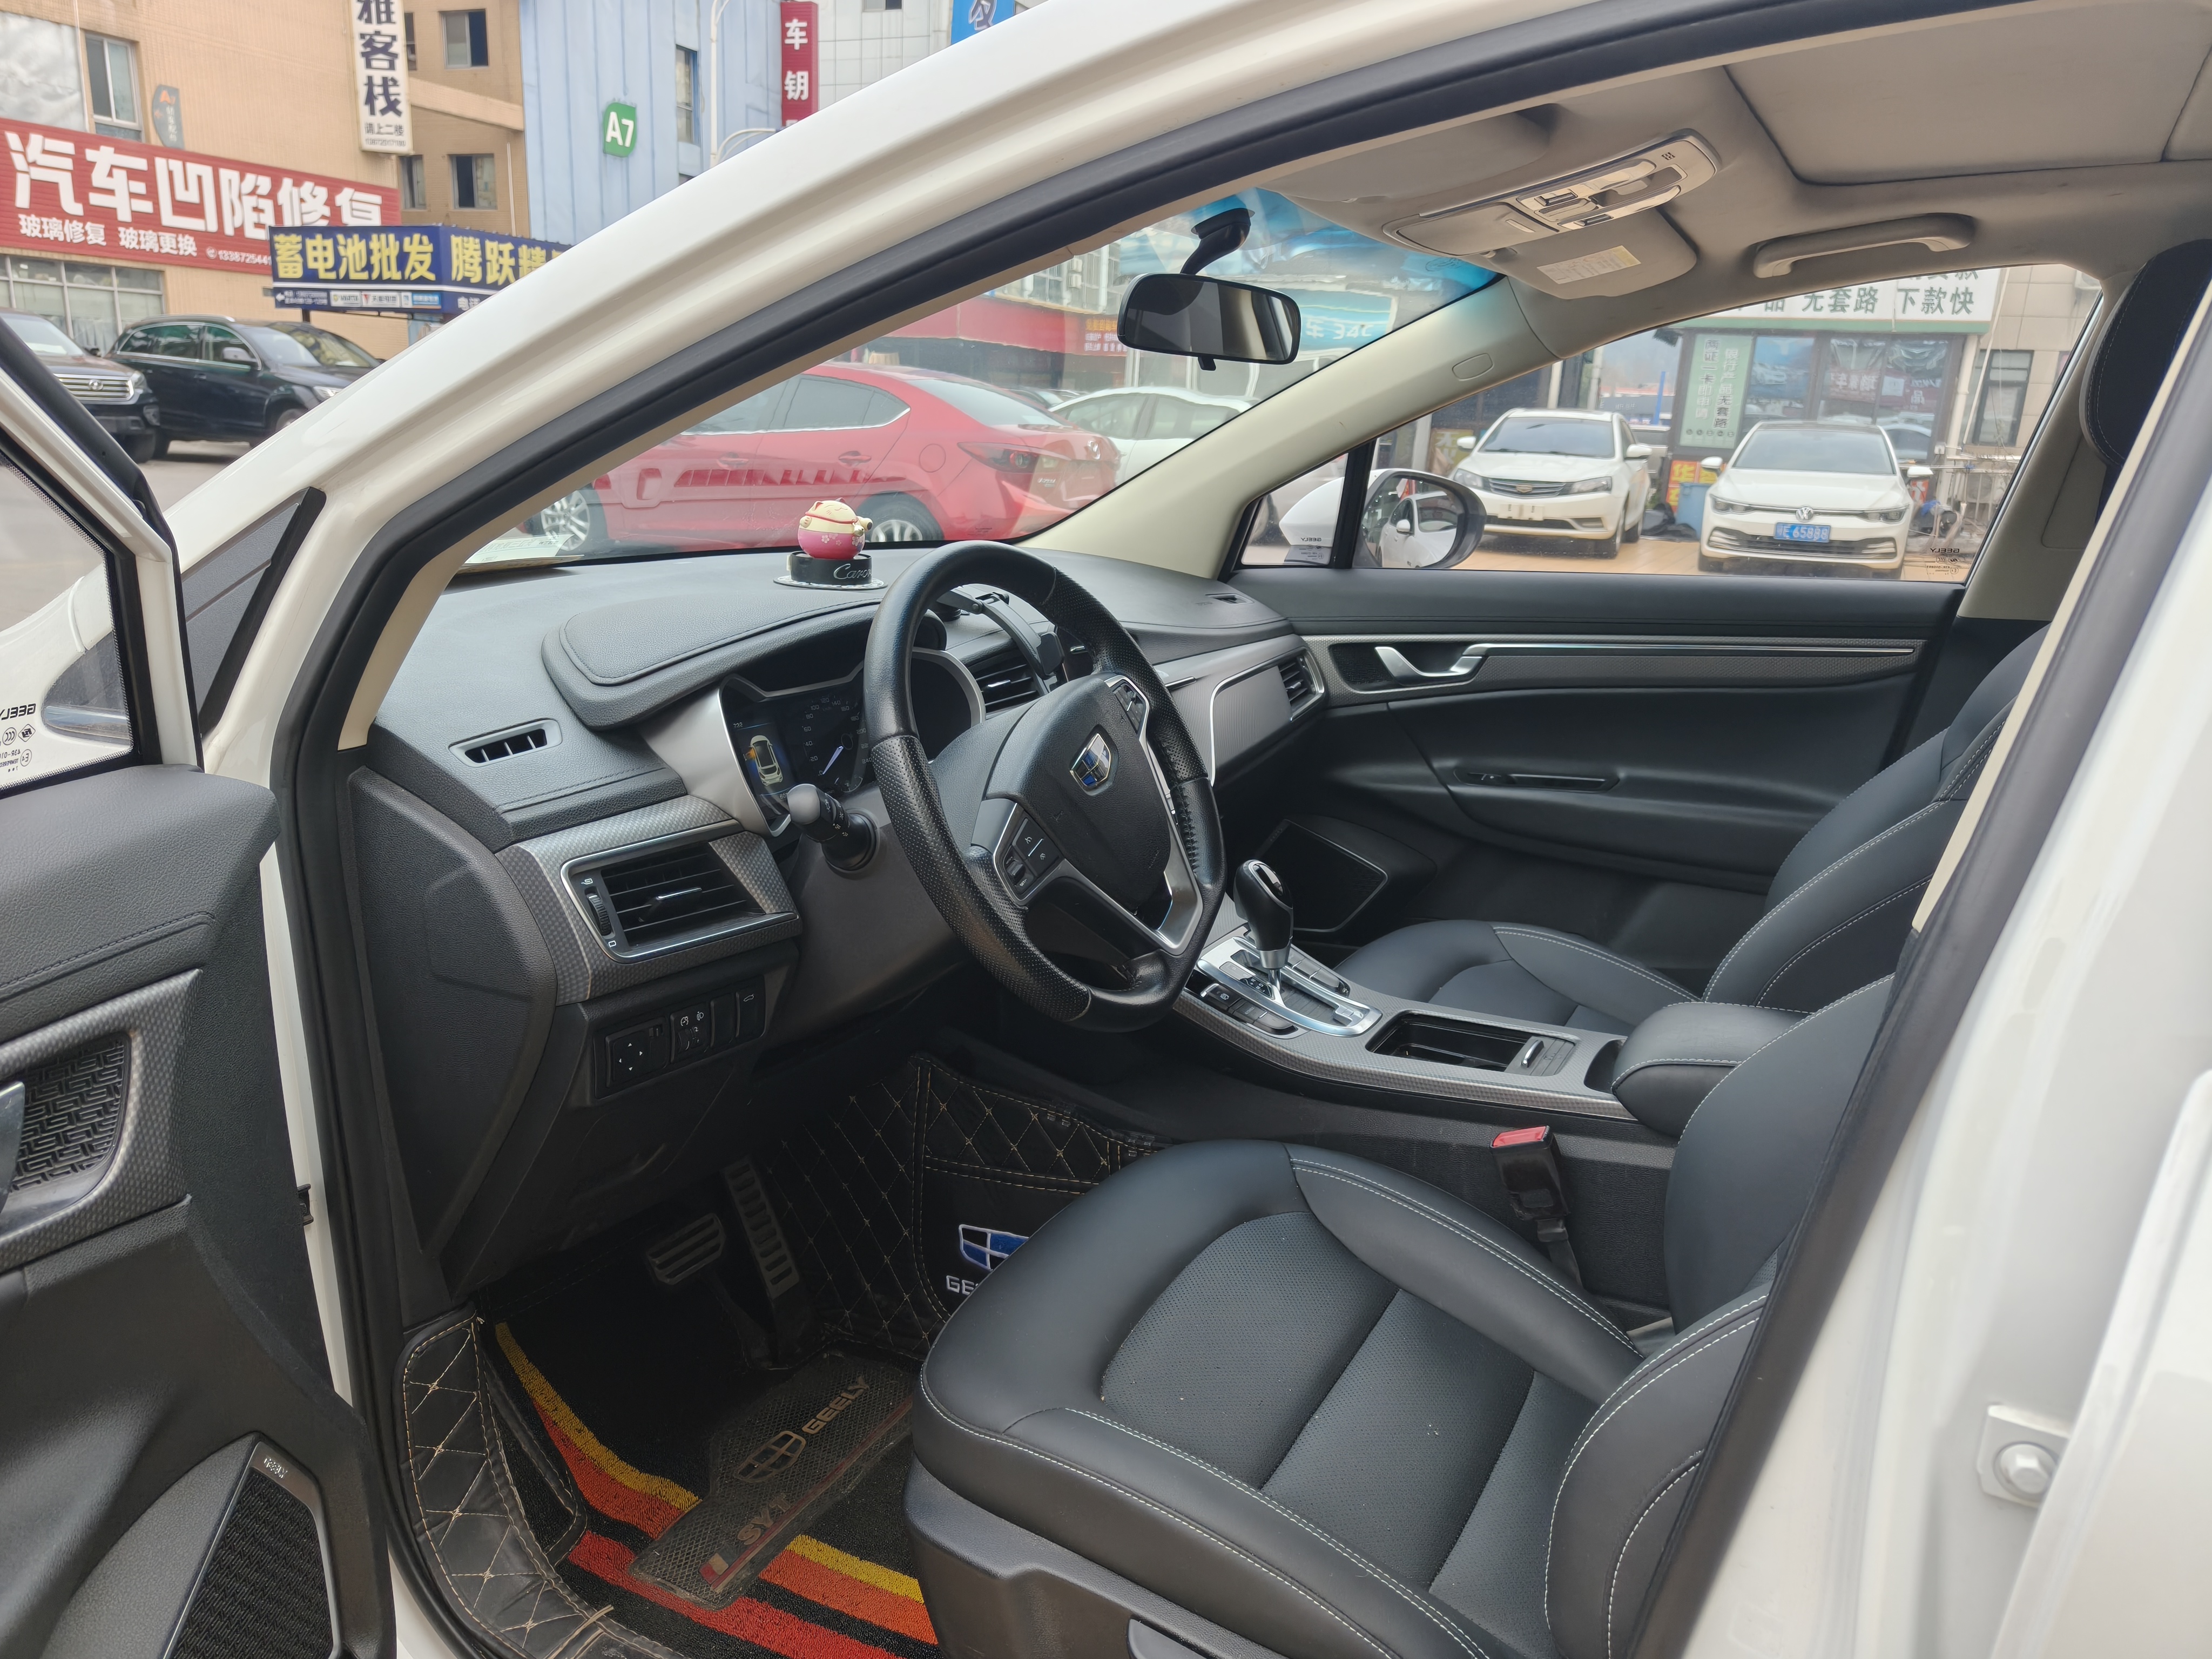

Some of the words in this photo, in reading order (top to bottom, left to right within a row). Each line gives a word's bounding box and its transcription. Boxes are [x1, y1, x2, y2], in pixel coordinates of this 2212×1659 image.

[784, 18, 809, 126] 车钥
[605, 111, 635, 147] A7
[5, 131, 382, 240] 汽车凹陷修复
[18, 214, 107, 246] 玻璃修复
[118, 227, 197, 257] 玻璃更换
[273, 233, 436, 282] 蓄电池批发
[450, 234, 563, 286] 腾跃精
[1802, 286, 1879, 314] 无套路
[1897, 286, 1976, 315] 下款快
[946, 1275, 979, 1296] GE
[801, 1375, 870, 1435] GEELY
